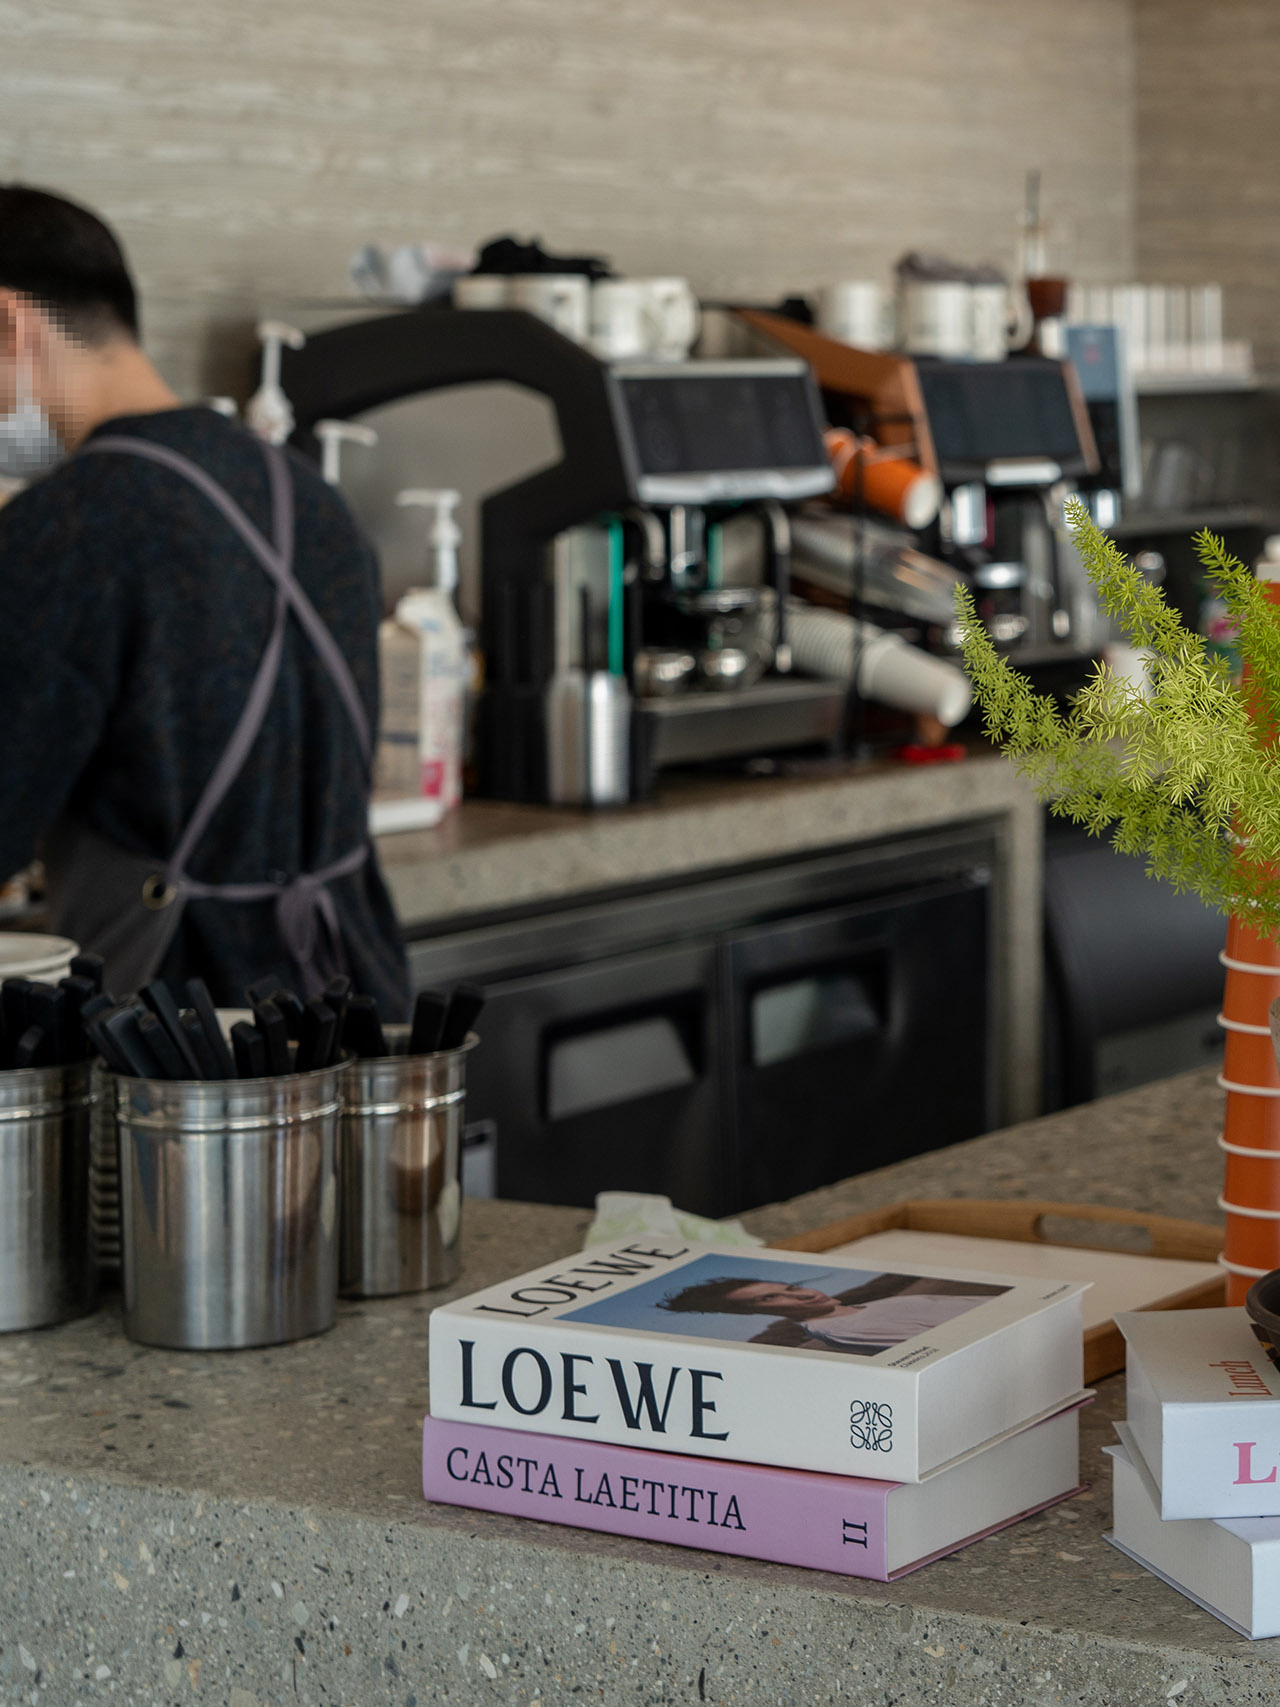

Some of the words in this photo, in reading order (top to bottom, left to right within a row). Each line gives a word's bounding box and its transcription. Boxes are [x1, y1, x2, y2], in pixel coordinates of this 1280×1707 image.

[473, 1243, 689, 1318] LOEWE
[459, 1338, 730, 1442] LOEWE
[1208, 1360, 1273, 1397] Lunch
[446, 1447, 561, 1498] CASTA
[574, 1467, 747, 1531] LAETITIA
[842, 1518, 868, 1549] II
